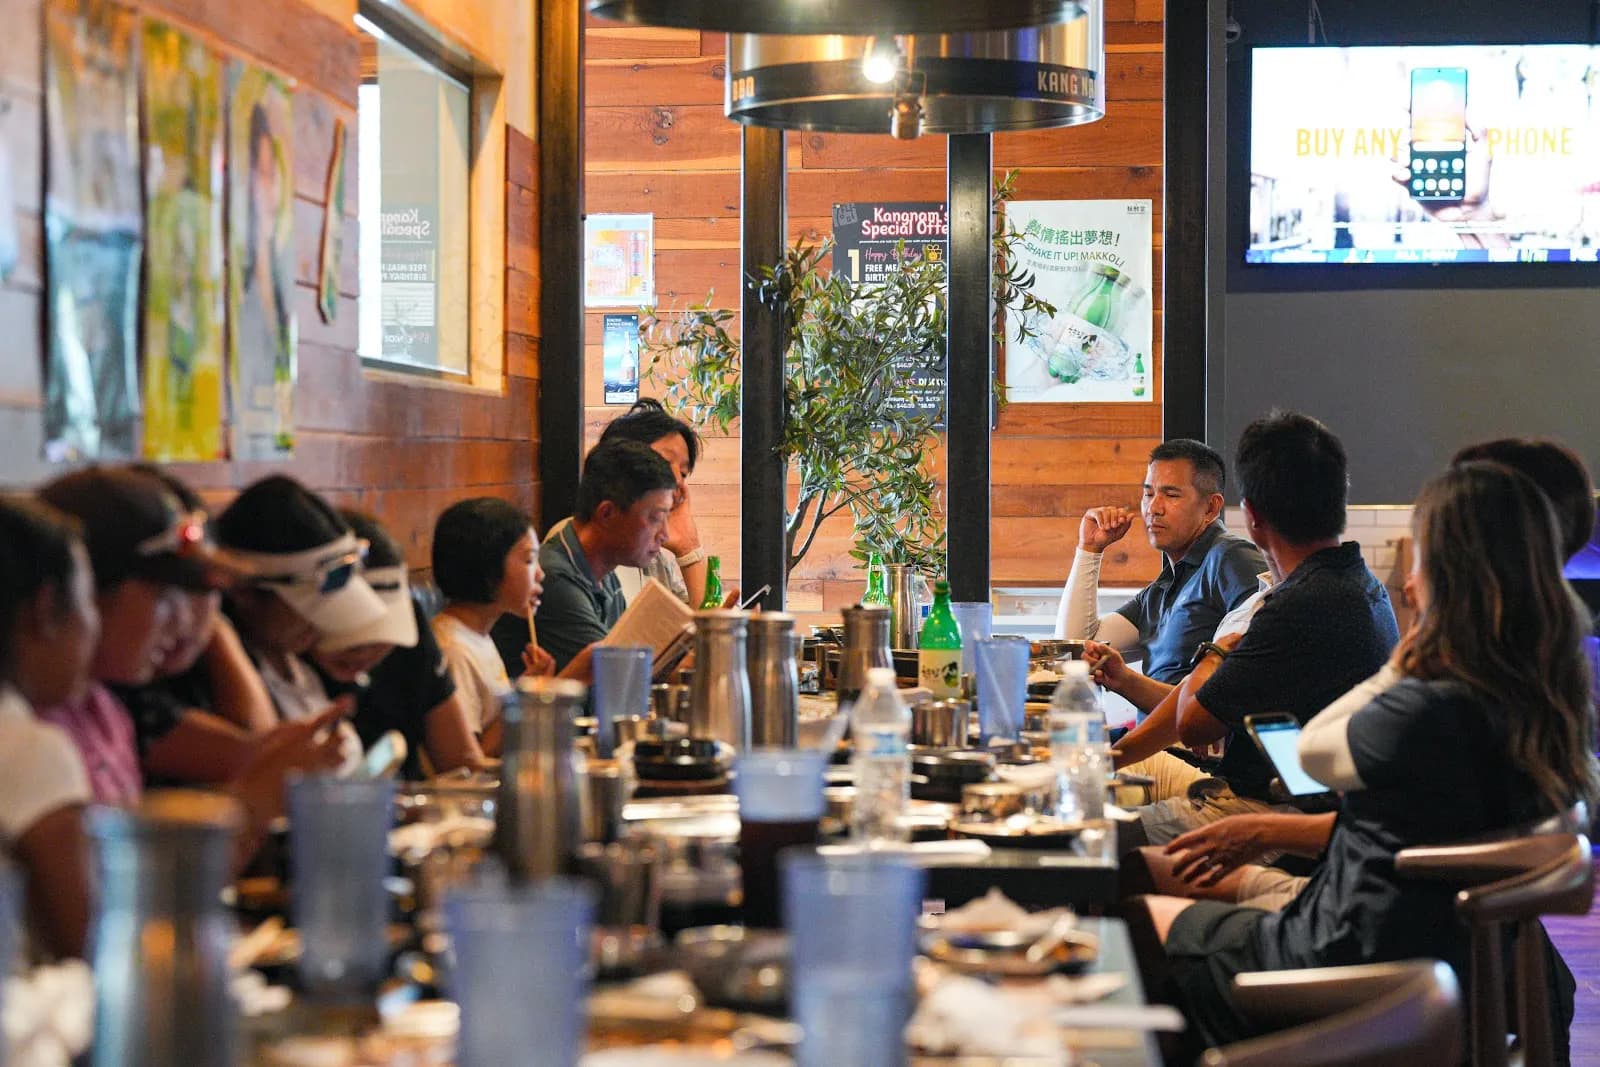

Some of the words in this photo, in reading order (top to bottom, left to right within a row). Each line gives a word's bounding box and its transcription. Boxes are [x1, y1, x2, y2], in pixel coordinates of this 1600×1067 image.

[1038, 71, 1078, 95] KANG
[1296, 127, 1345, 157] BUY
[1353, 127, 1403, 161] ANY
[1487, 127, 1575, 157] PHONE
[861, 218, 914, 239] Special
[916, 217, 948, 236] Offe
[1024, 241, 1052, 260] SHAKE
[847, 248, 860, 282] 1
[865, 263, 884, 273] FREE
